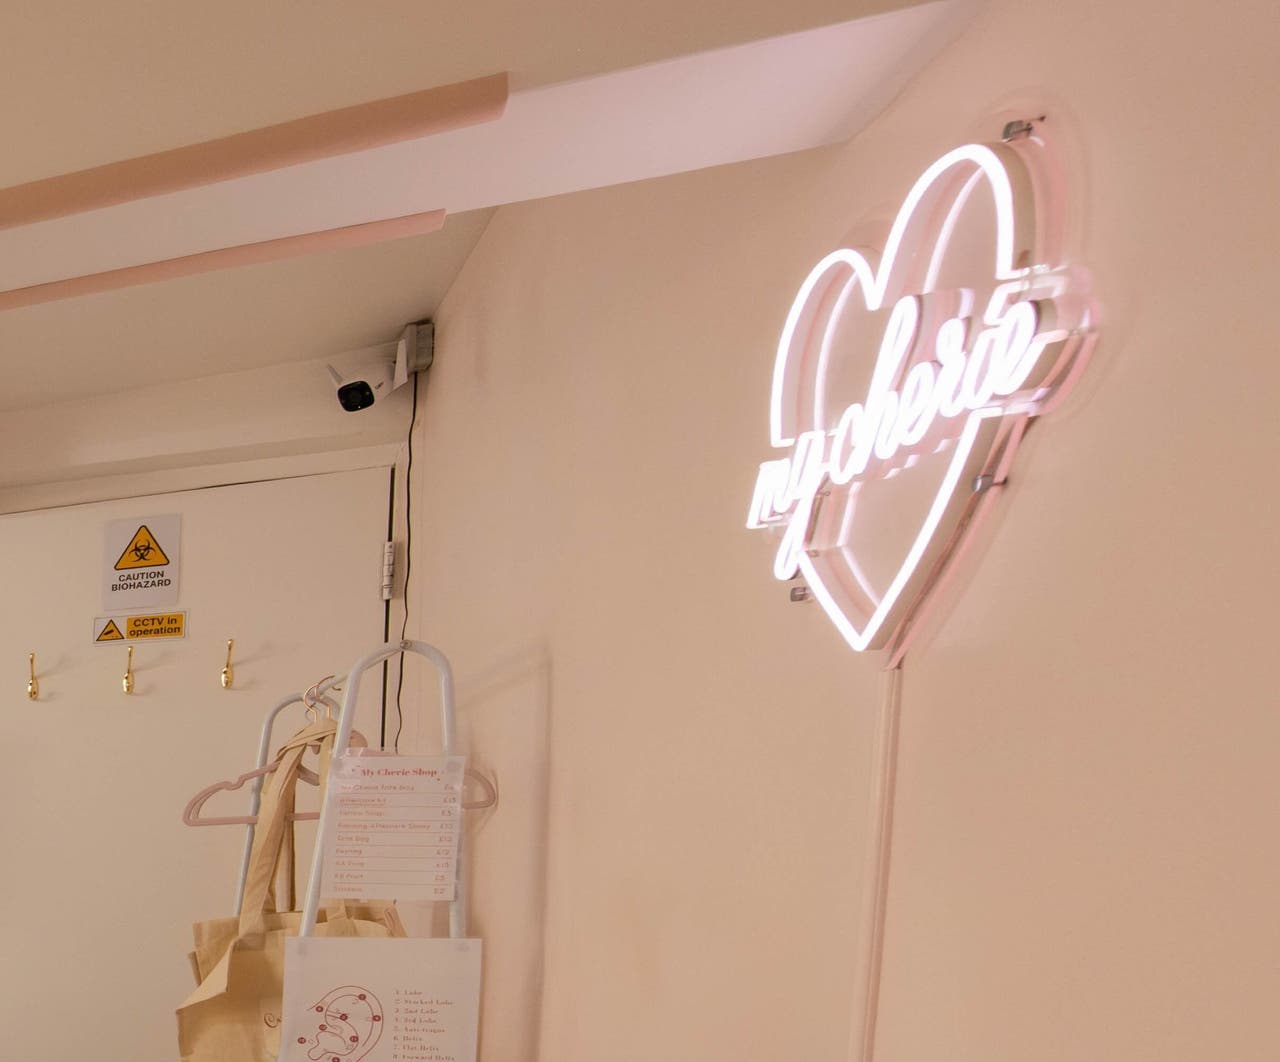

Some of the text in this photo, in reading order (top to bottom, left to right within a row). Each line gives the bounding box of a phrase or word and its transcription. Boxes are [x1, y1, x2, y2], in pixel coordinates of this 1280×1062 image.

[747, 430, 826, 580] my
[118, 571, 165, 582] CAUTION
[111, 579, 171, 592] BIOHAZARD
[133, 617, 164, 627] CCTV
[129, 626, 181, 637] operation
[412, 767, 438, 777] Shop
